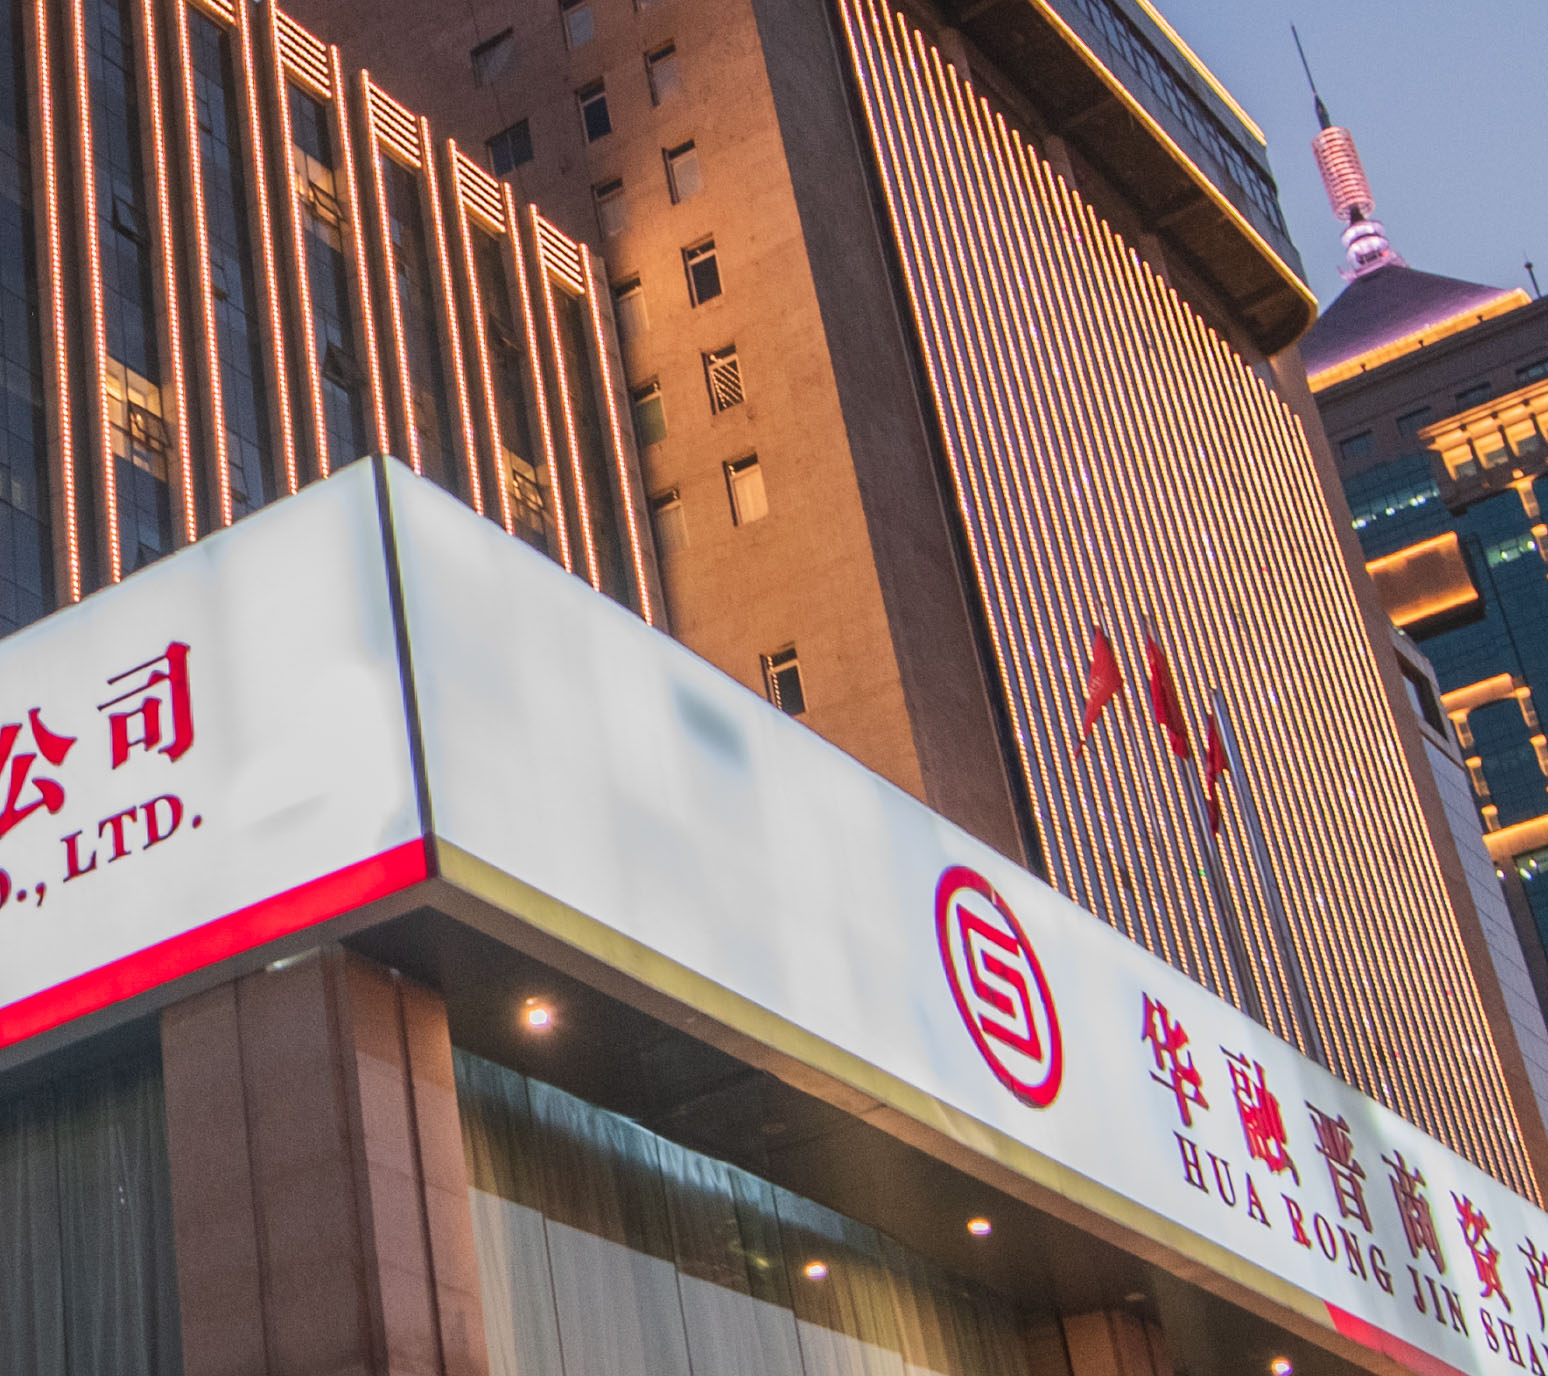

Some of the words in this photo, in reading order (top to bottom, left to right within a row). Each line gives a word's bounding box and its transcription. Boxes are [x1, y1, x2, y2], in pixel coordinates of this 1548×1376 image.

[1172, 1130, 1272, 1228] HUA
[1280, 1192, 1395, 1296] RONG
[1406, 1264, 1471, 1338] JIN
